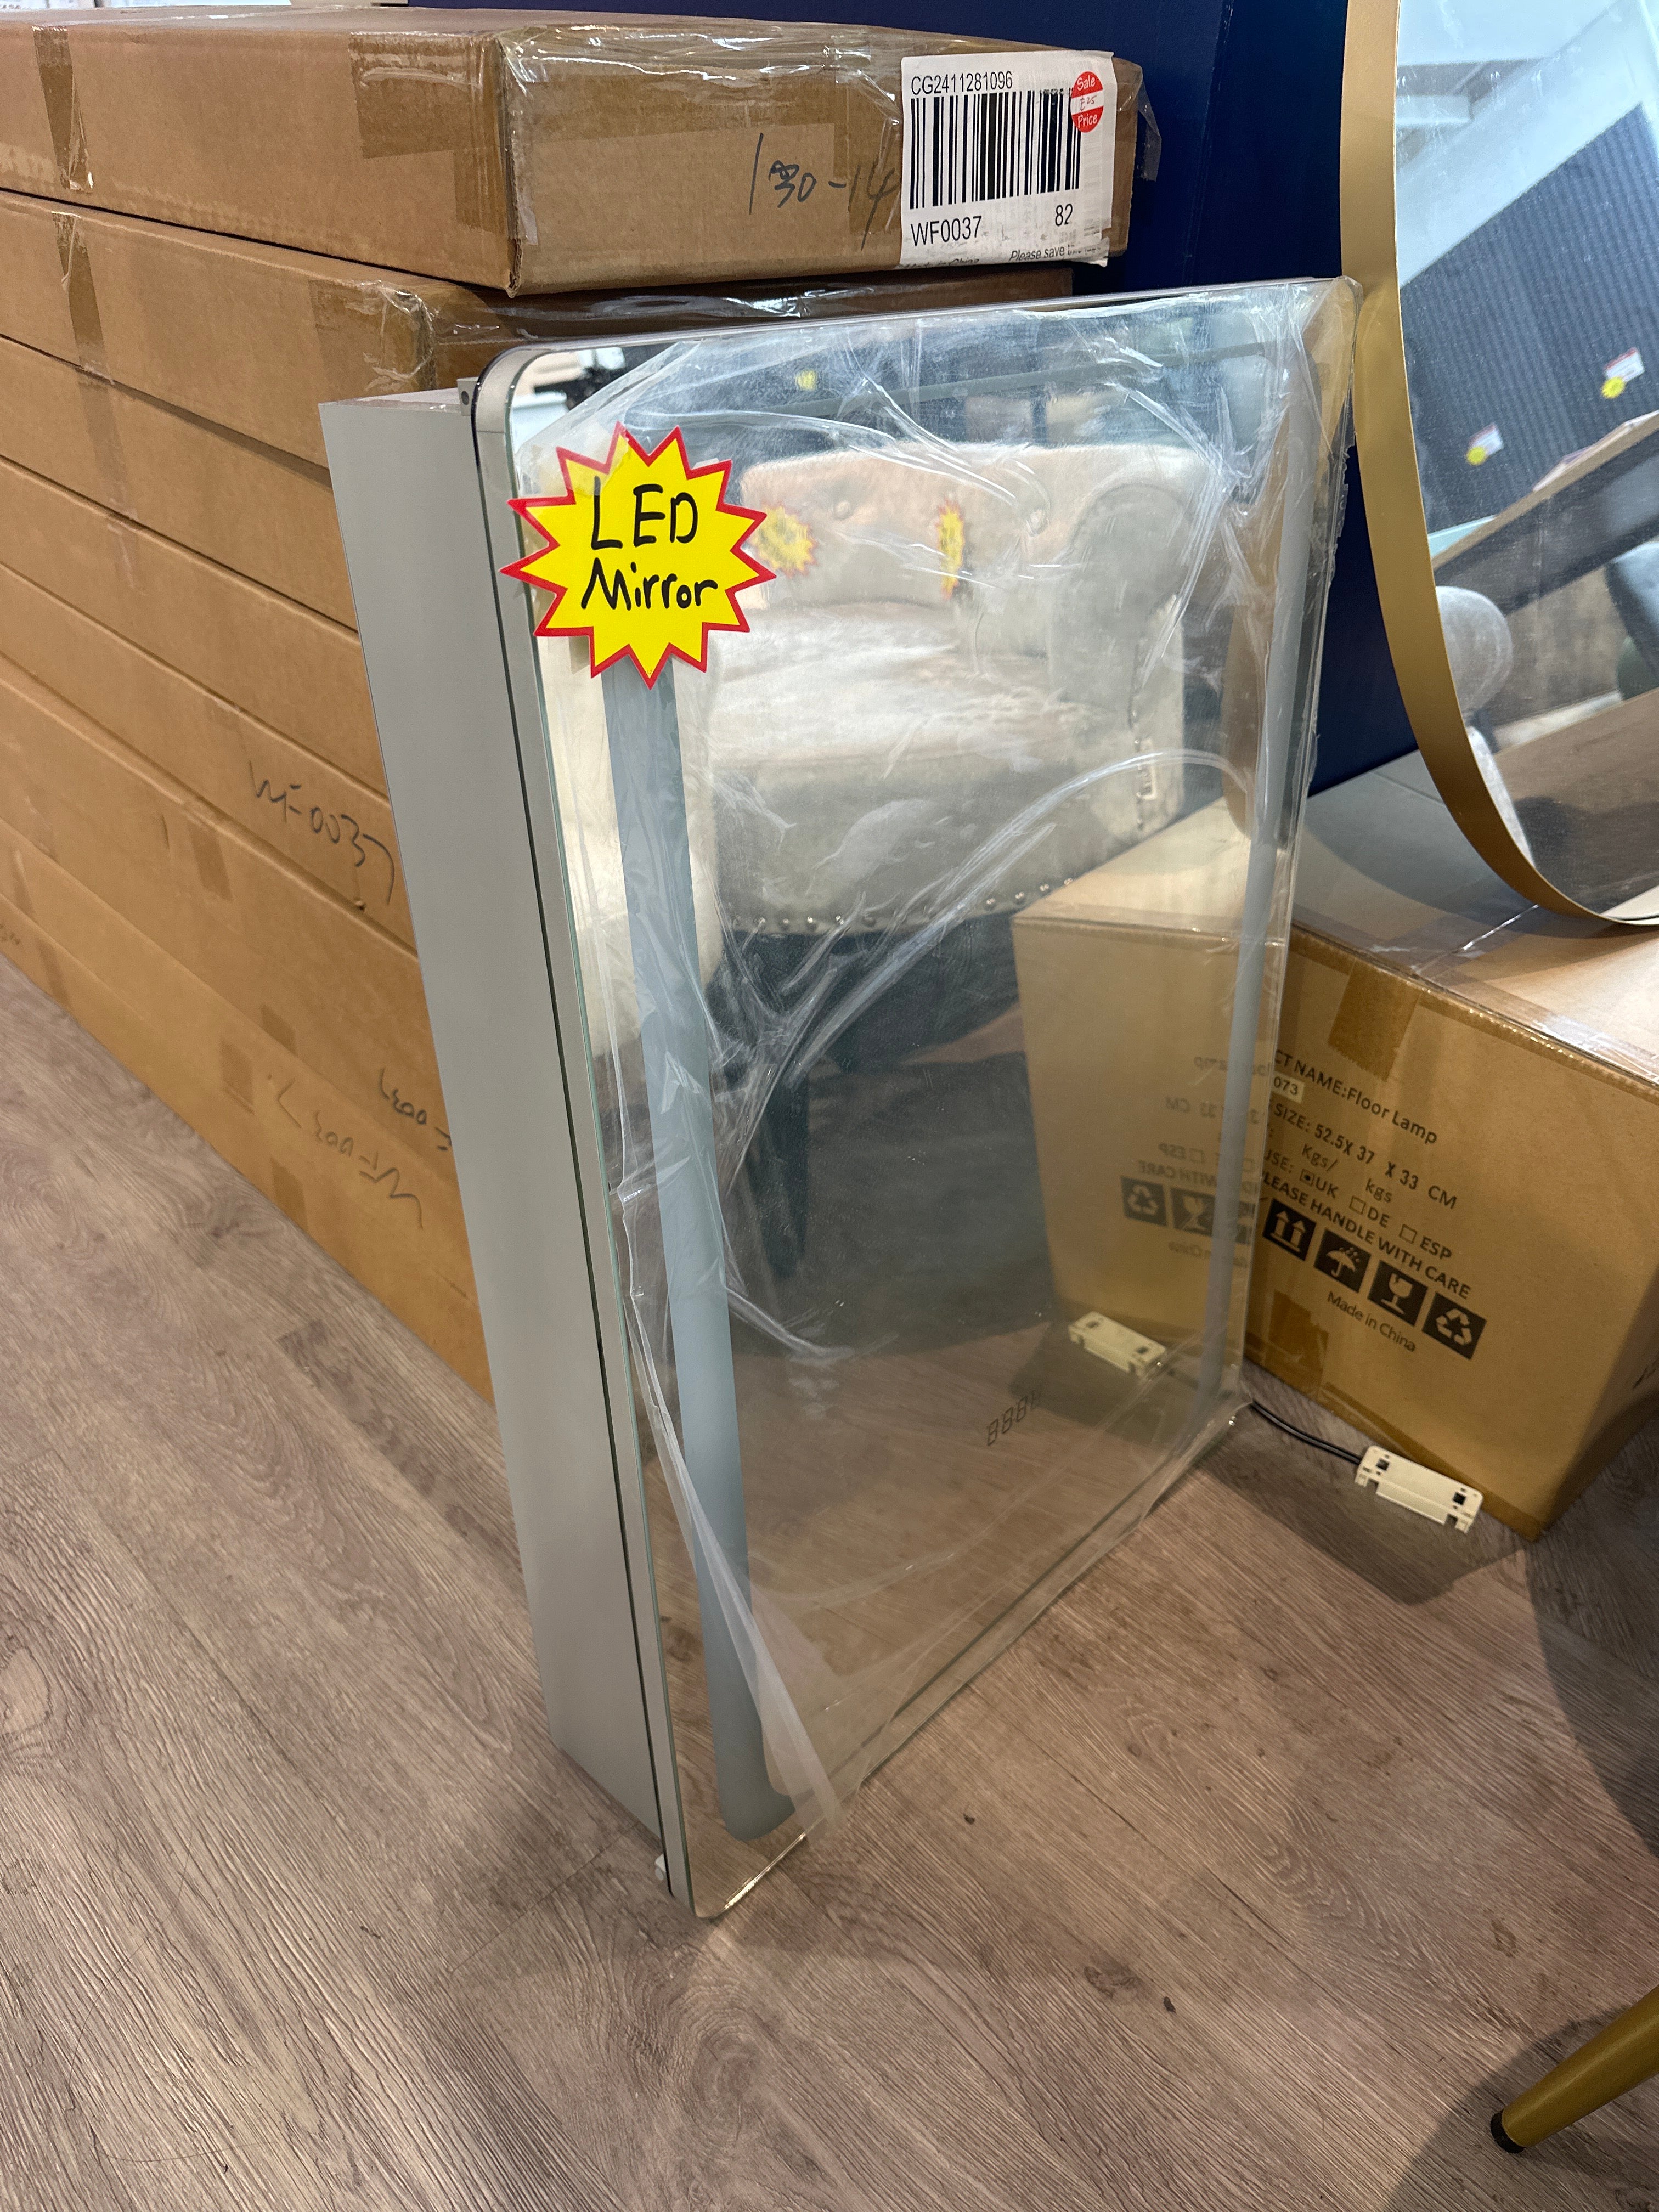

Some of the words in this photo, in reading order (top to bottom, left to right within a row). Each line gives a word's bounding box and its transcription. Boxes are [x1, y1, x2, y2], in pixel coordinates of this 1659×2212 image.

[911, 70, 1013, 95] CG2411281096
[1077, 75, 1096, 91] Sale
[1077, 113, 1098, 128] Price
[911, 215, 982, 246] WF0037
[1054, 204, 1074, 227] 82
[1008, 250, 1042, 263] Please
[1043, 246, 1065, 259] save
[591, 476, 698, 550] LED
[580, 557, 719, 612] Mirror
[1392, 1110, 1437, 1144] Lamp
[1273, 1103, 1310, 1132] SIZE:
[1357, 1145, 1375, 1164] 37
[1384, 1161, 1396, 1178] X
[1400, 1169, 1419, 1190] 33
[1428, 1184, 1457, 1210] CM
[1316, 1176, 1339, 1199] UK
[1367, 1207, 1390, 1228] DE
[1419, 1235, 1452, 1260] ESP
[1310, 1198, 1375, 1245] HANDLE
[1378, 1236, 1423, 1272] WITH
[1425, 1266, 1471, 1300] CARE
[1327, 1290, 1363, 1322] Made
[1365, 1313, 1377, 1330] in
[1379, 1322, 1416, 1353] China
